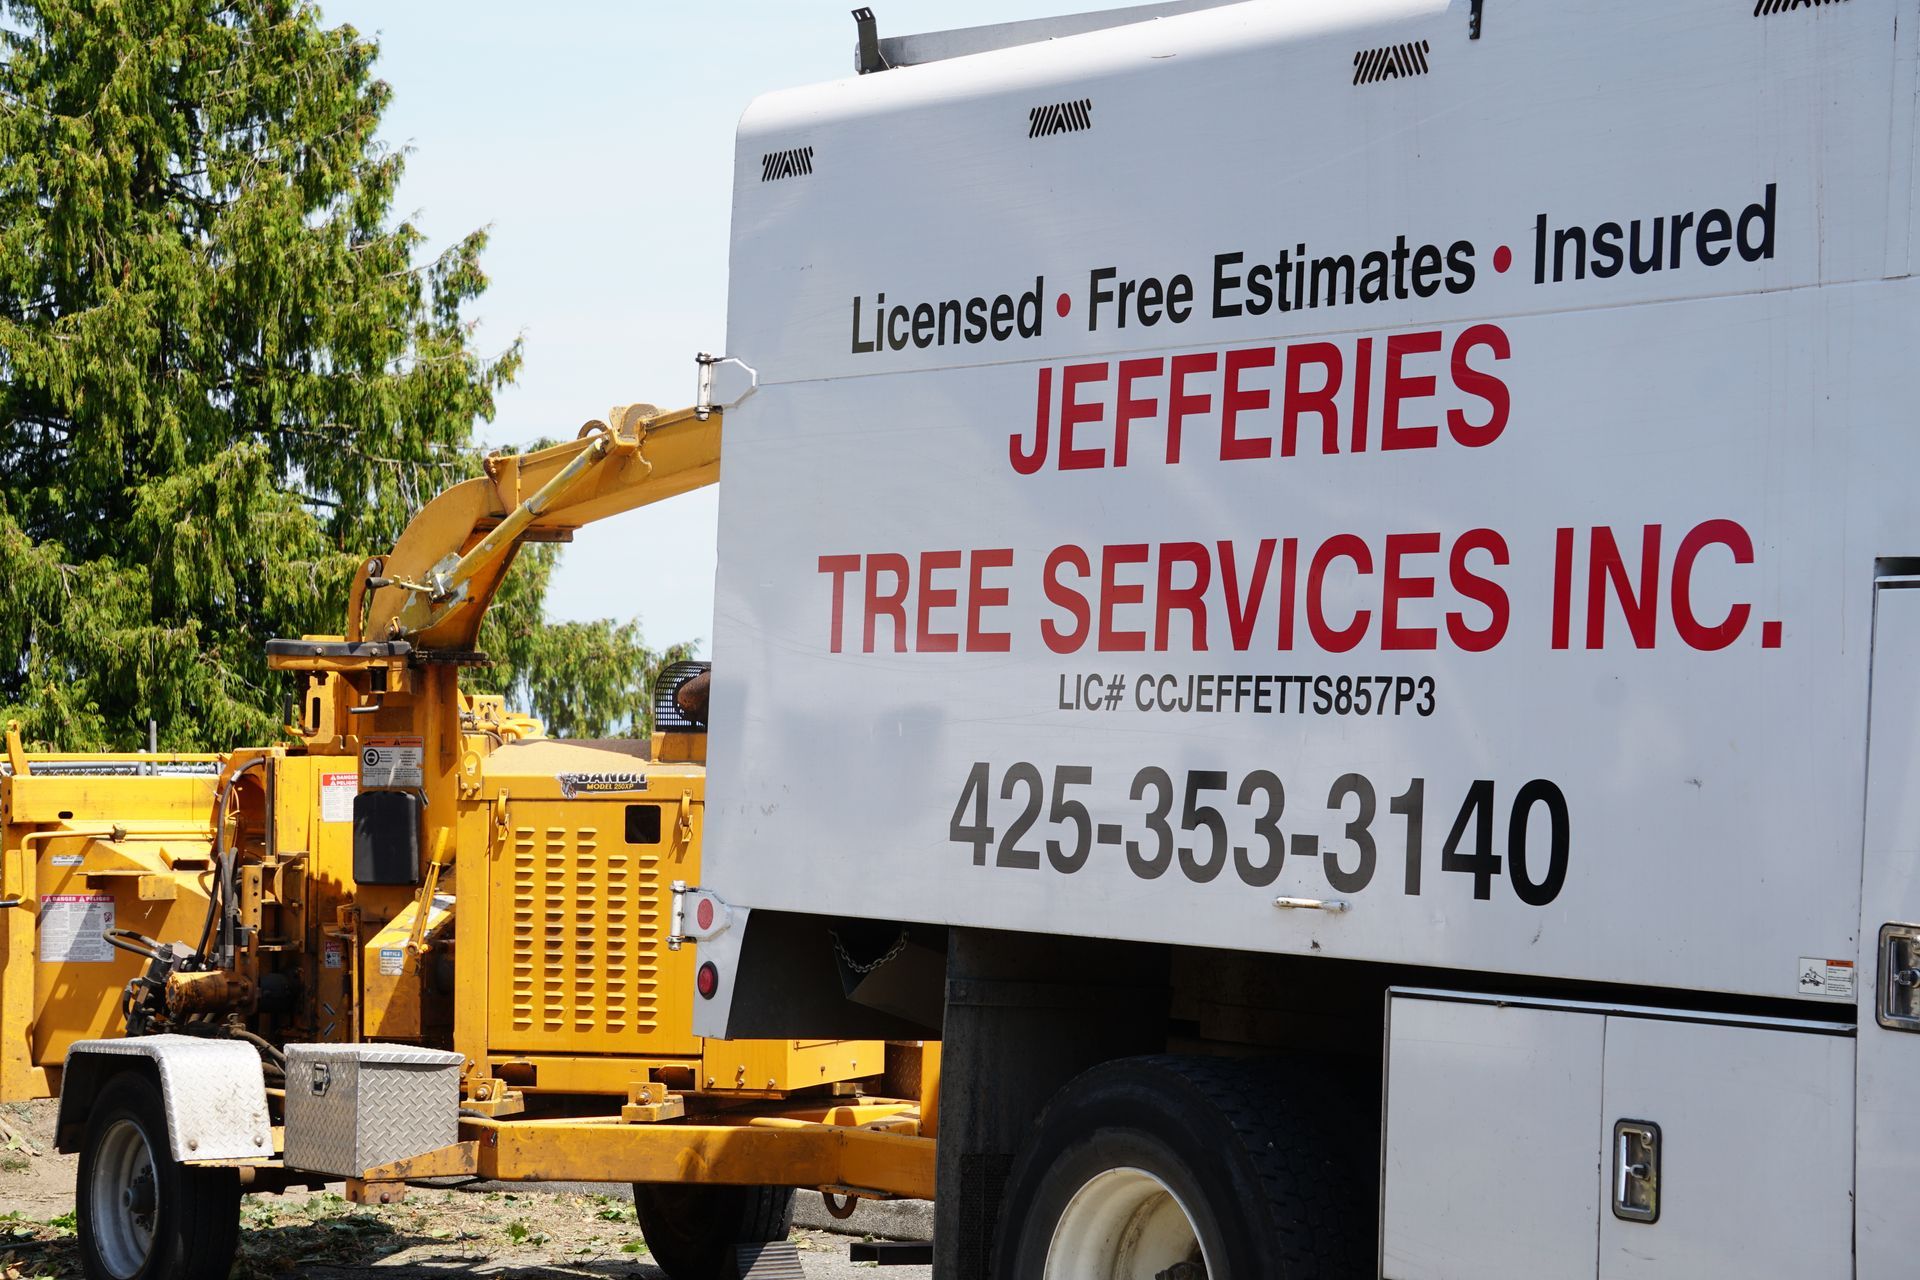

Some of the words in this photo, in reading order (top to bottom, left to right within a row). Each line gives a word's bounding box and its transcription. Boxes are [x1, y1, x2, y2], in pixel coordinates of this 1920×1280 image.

[852, 276, 1044, 354] Licensed
[1089, 266, 1194, 331] Free
[1213, 242, 1476, 319] Estimates
[1535, 183, 1777, 285] Insured
[1009, 323, 1511, 475] JEFFERIES
[818, 548, 1013, 652] TREE
[1041, 528, 1510, 654] SERVICES
[1551, 519, 1782, 652] INC.
[1058, 673, 1126, 711] LIC#
[1135, 673, 1436, 717] CCJEFFETTS857P3
[949, 761, 1570, 907] 425-353-3140
